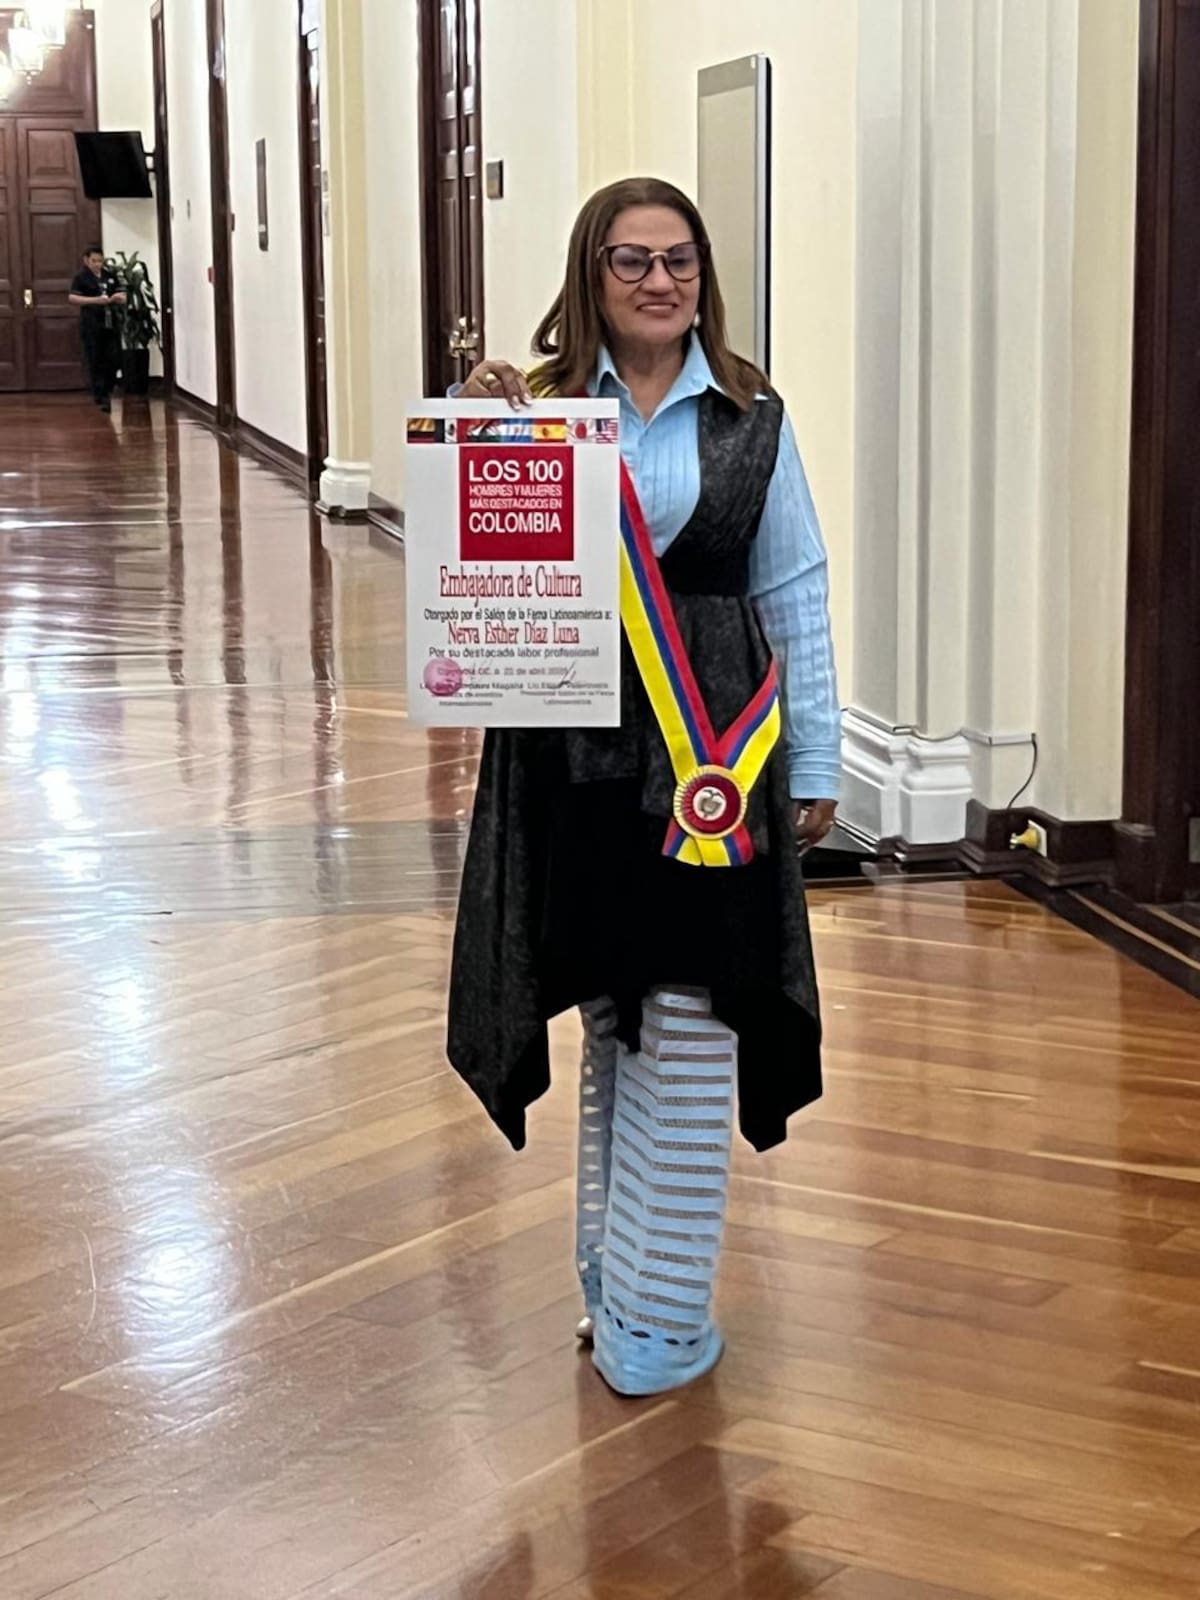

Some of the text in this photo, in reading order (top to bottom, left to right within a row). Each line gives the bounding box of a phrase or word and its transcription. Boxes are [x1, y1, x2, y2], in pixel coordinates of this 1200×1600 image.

[469, 460, 563, 481] LOS 100
[469, 484, 562, 496] HOMBRES Y MUJERES
[489, 498, 549, 509] DESTACADOS
[549, 498, 562, 509] EN
[469, 512, 562, 533] COLOMBIA
[440, 565, 582, 608] Embajadora de Cultura
[424, 607, 459, 622] Otorgado
[461, 610, 472, 622] por
[475, 607, 482, 620] el
[484, 607, 505, 620] Salón
[507, 607, 517, 620] de
[519, 607, 525, 620] la
[527, 608, 547, 620] Fama
[448, 620, 580, 644] Nerva Esther Díaz Luna
[429, 647, 599, 658] Por su destacada labor profesional
